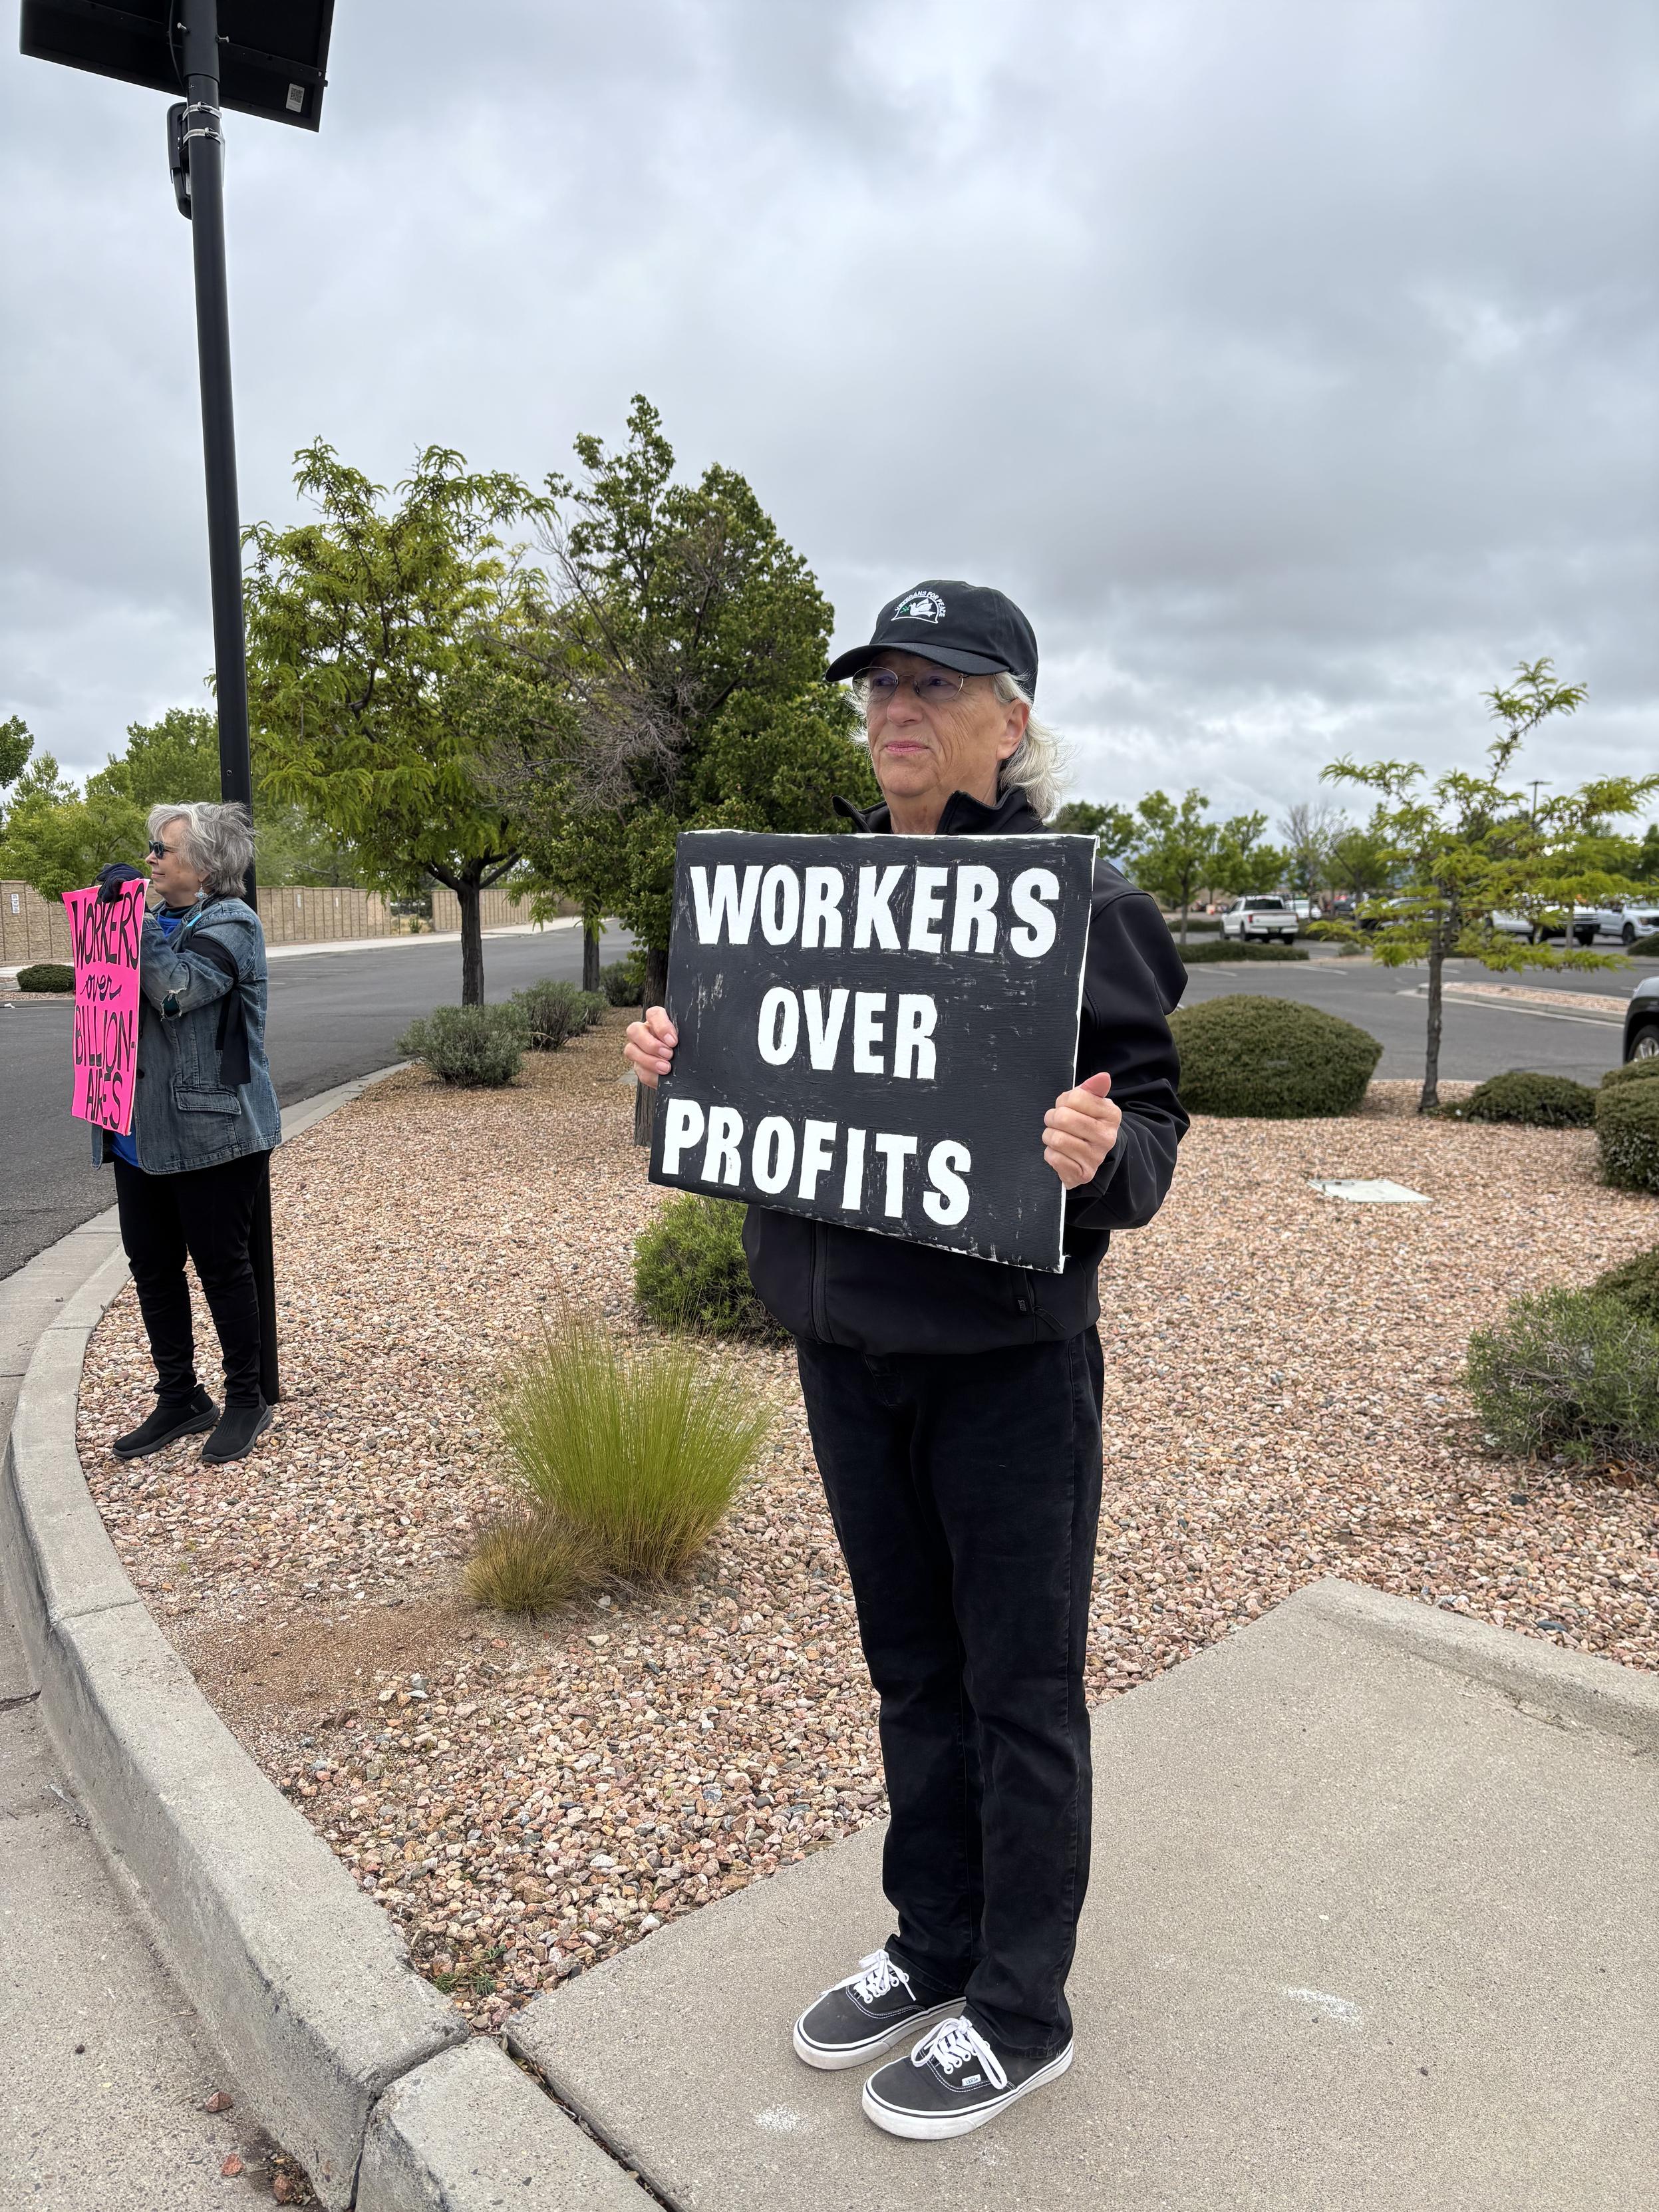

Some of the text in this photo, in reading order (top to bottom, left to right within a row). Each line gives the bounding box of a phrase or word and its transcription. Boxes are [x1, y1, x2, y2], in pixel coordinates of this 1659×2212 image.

[927, 591, 939, 601] FOR
[71, 883, 144, 970] WORKERS
[690, 864, 1060, 958] WORKERS
[80, 974, 122, 1002] over
[76, 1005, 135, 1072] BILLION-
[758, 987, 938, 1080] OVER
[85, 1068, 122, 1130] AIRES
[662, 1098, 971, 1225] PROFITS
